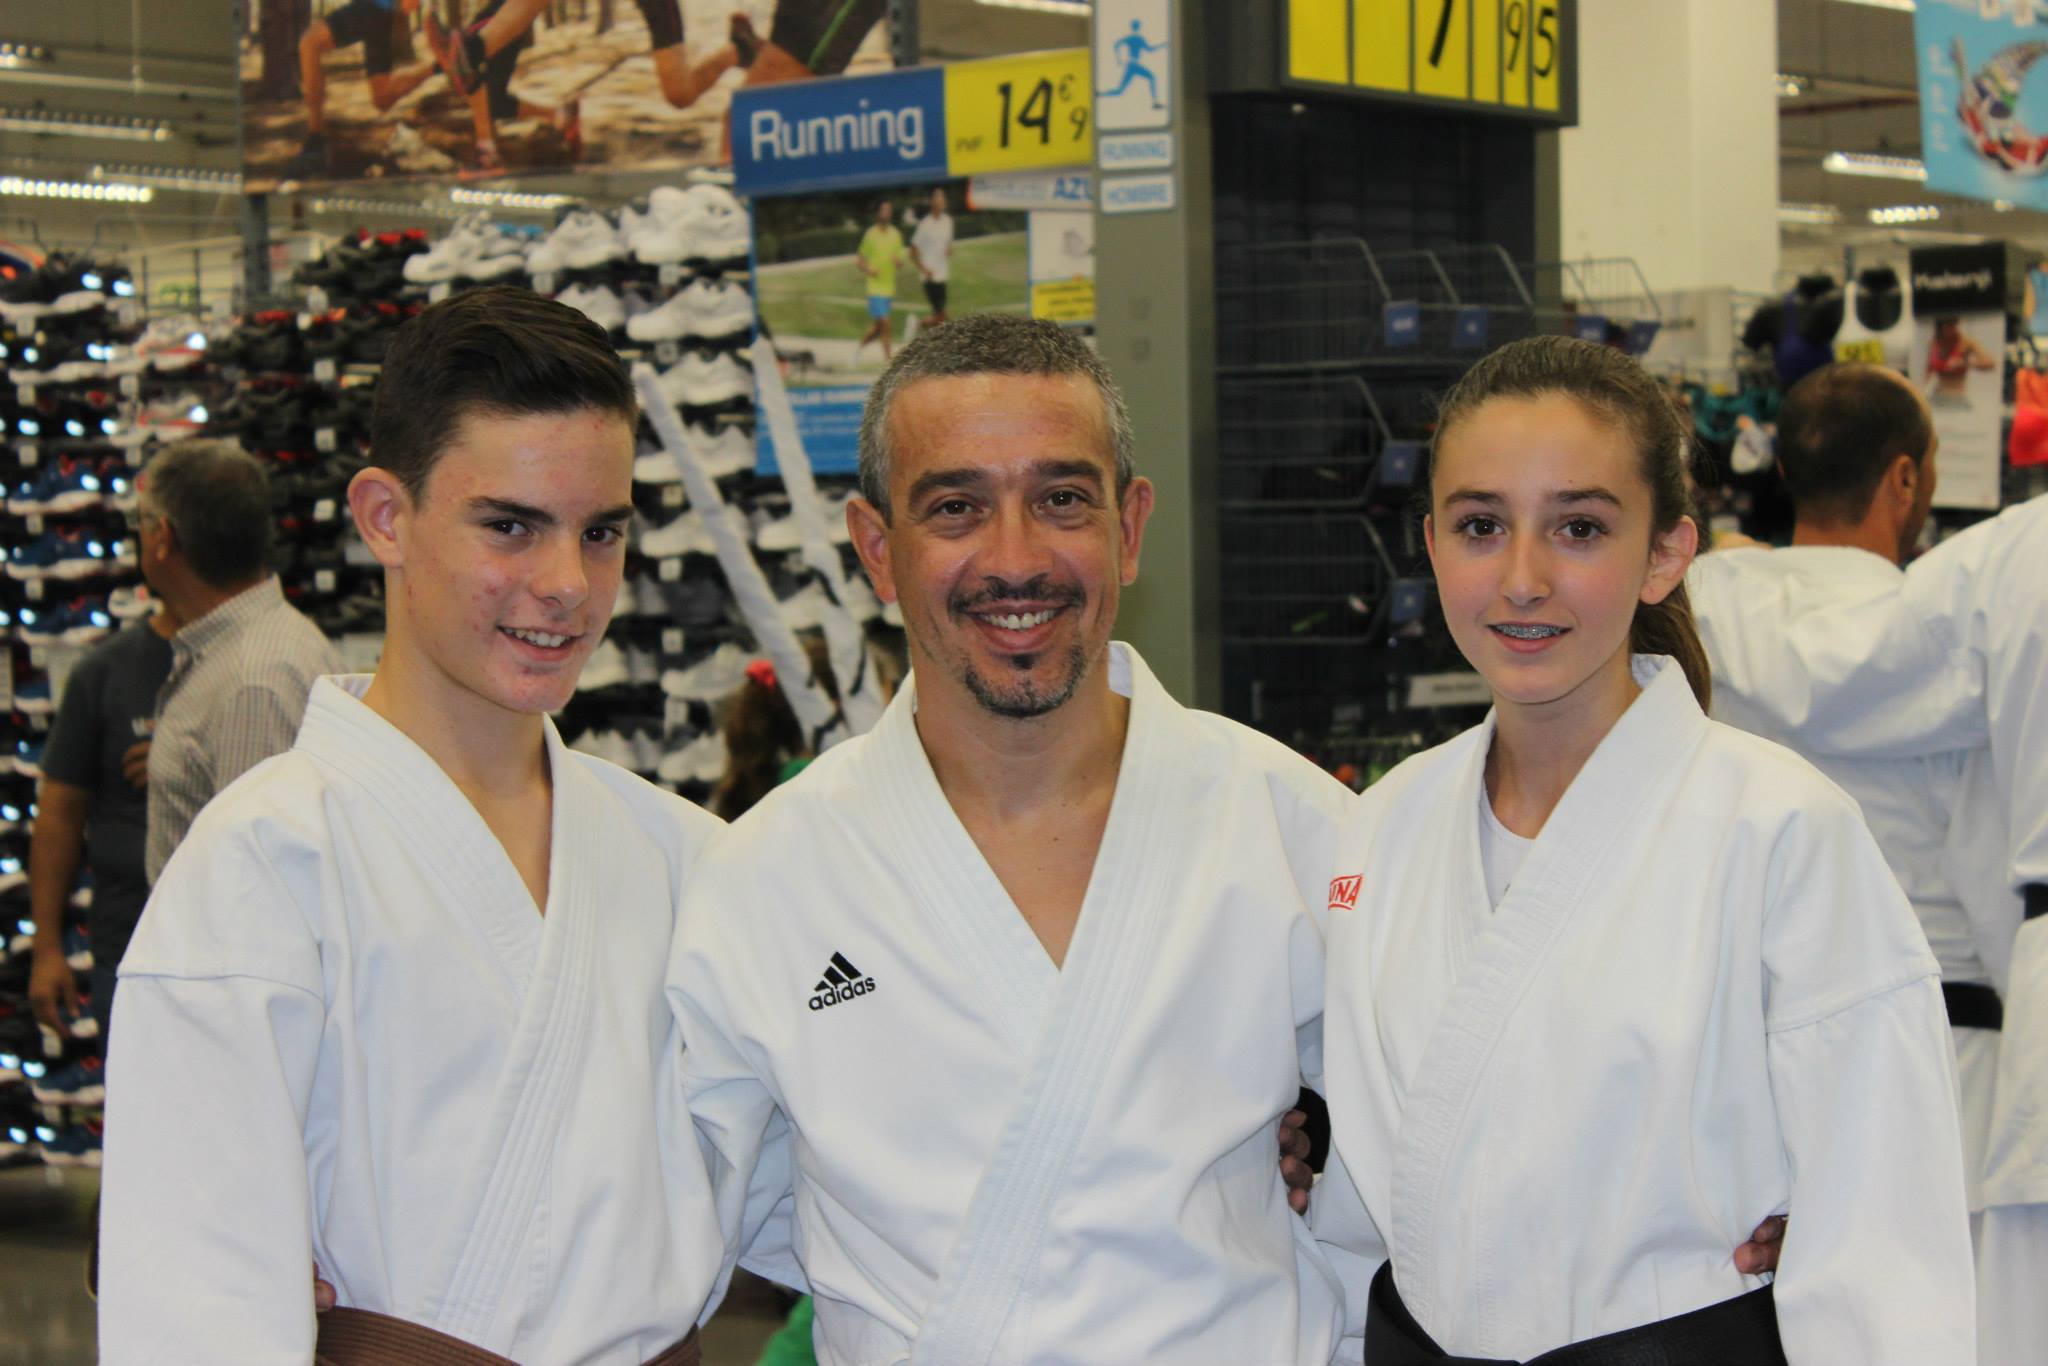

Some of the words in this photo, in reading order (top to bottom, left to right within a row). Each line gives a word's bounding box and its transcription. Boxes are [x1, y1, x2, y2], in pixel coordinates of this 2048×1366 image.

[751, 98, 924, 162] Running
[1103, 141, 1169, 160] RUNNING
[1106, 185, 1170, 205] HOMBRE
[808, 976, 876, 1011] adidas
